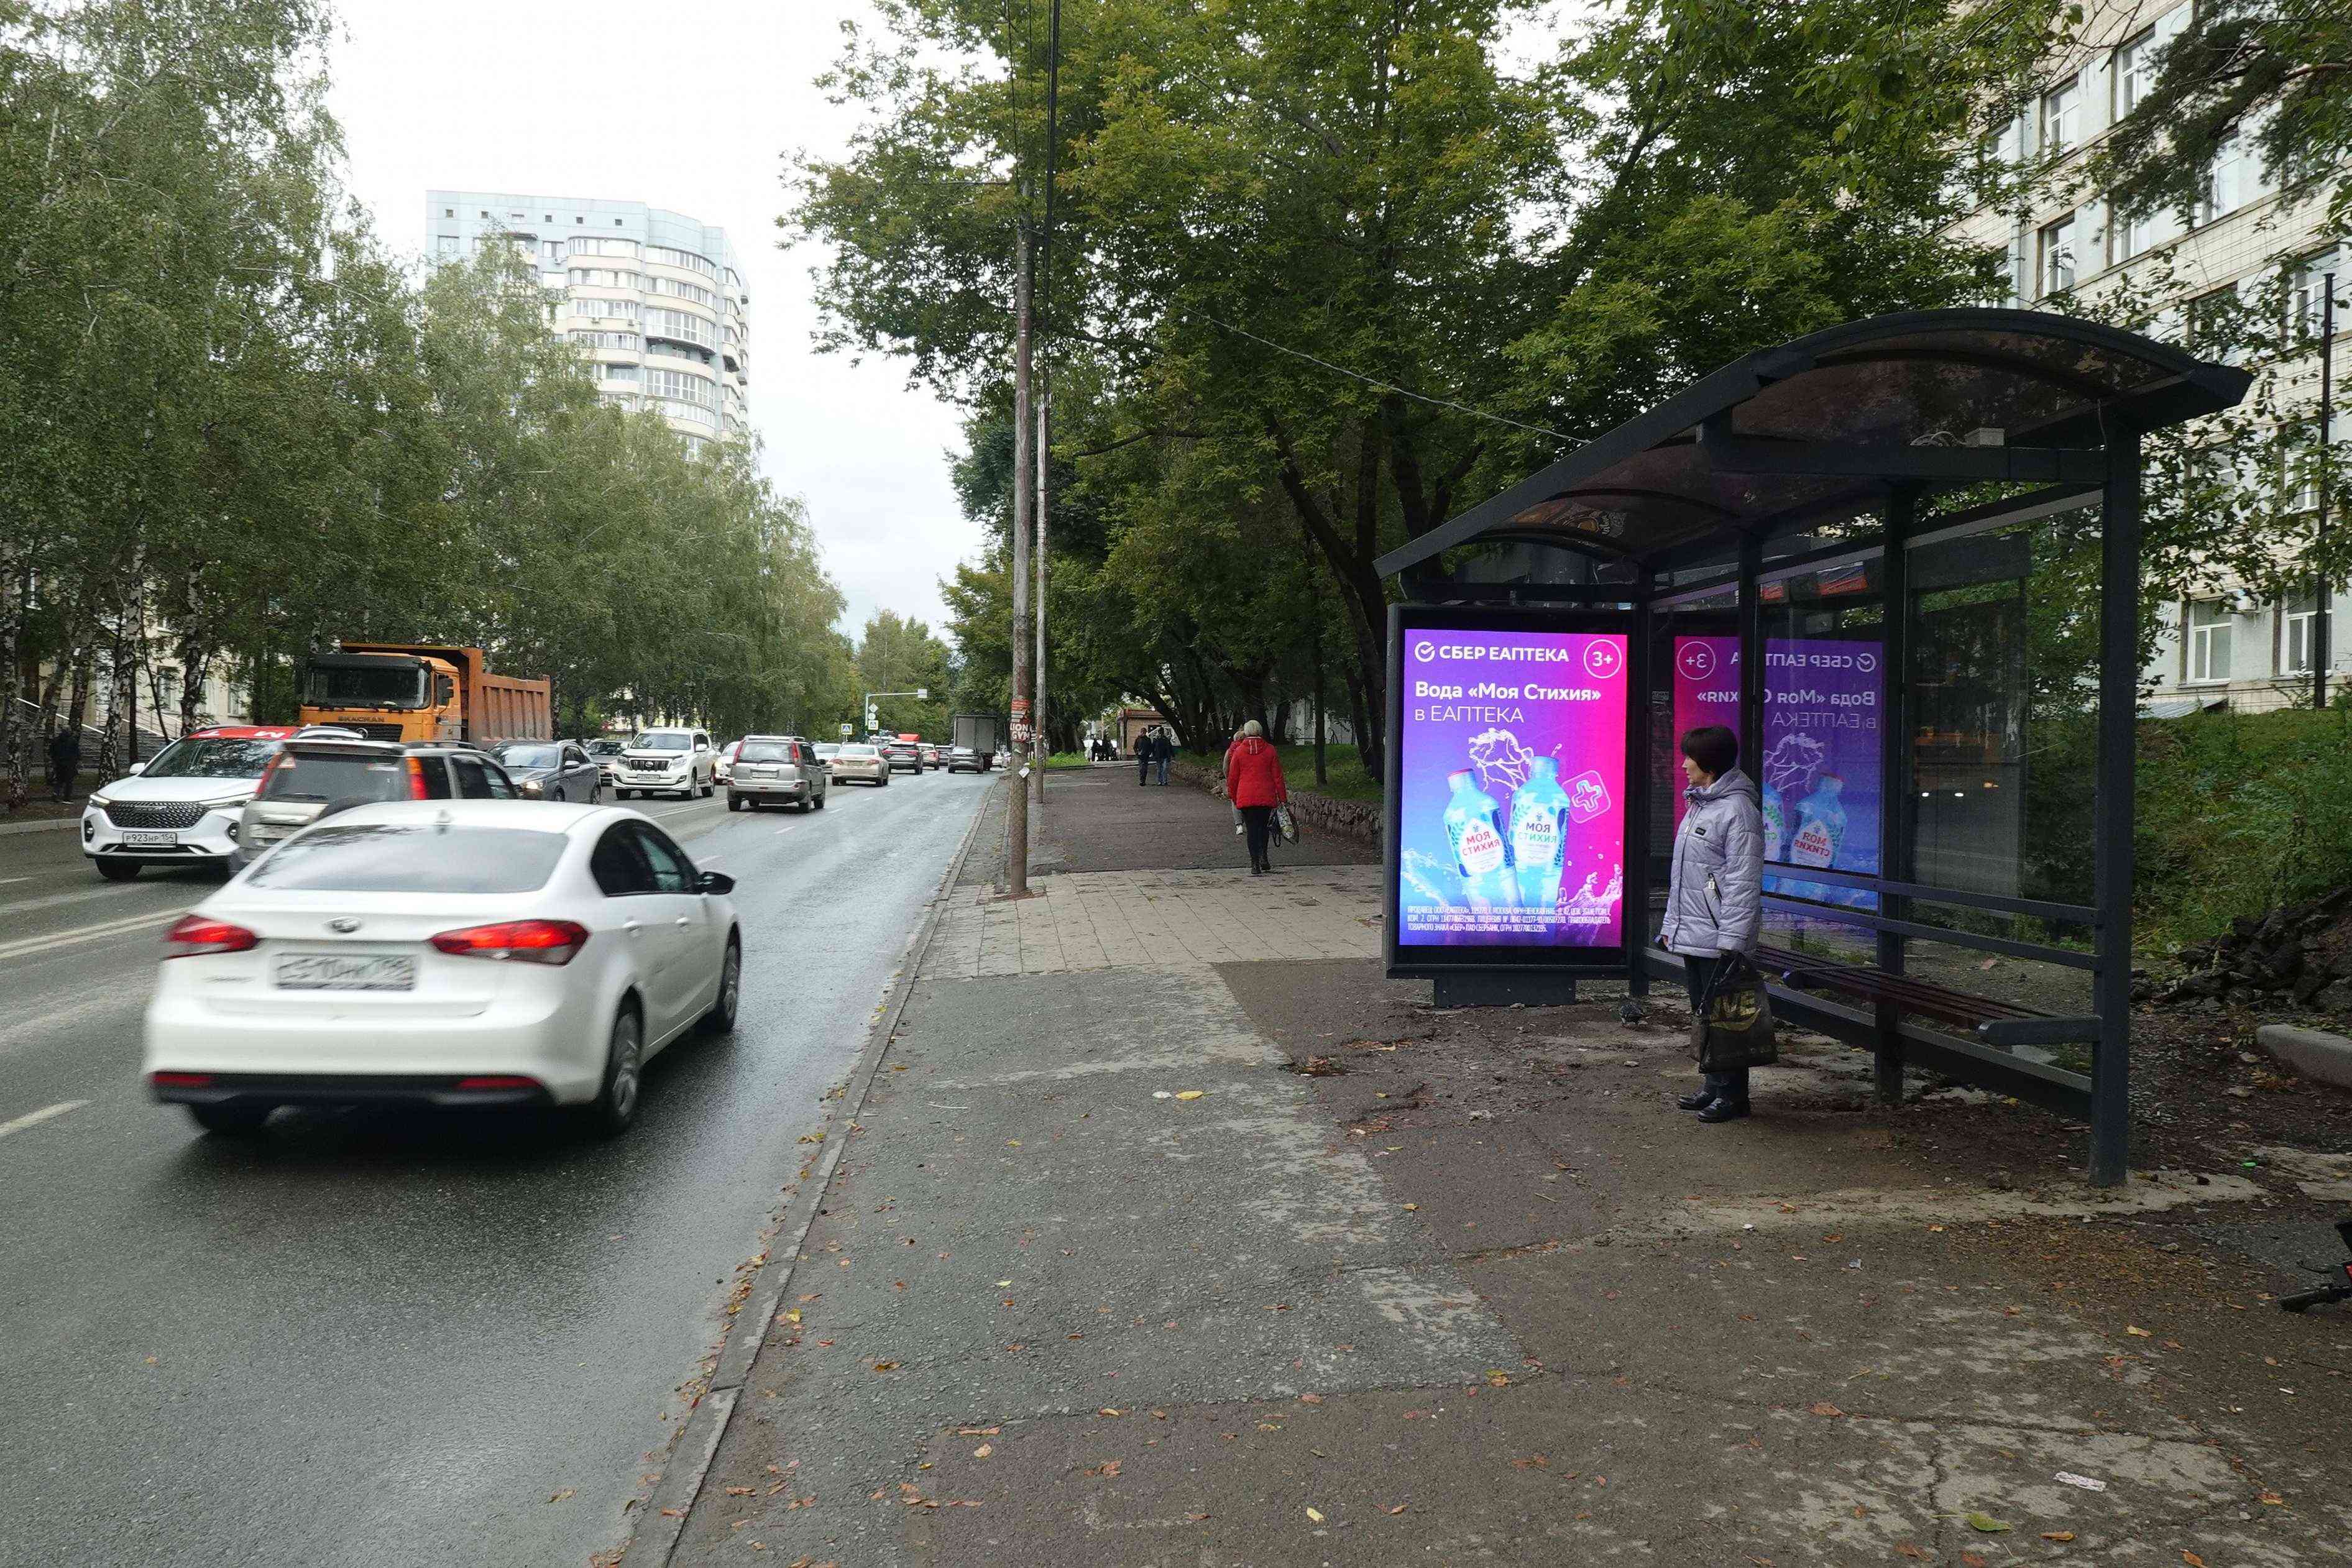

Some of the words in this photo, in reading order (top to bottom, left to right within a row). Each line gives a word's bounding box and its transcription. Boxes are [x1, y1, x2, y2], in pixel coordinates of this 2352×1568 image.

[1439, 645, 1486, 660] СБЕР
[1489, 646, 1569, 663] ЕАПТЕКА
[1591, 651, 1614, 667] 3+
[1415, 681, 1463, 700] Вода
[1468, 682, 1519, 700] «Моя
[1523, 683, 1602, 702] Стихия»
[1415, 708, 1425, 722] в
[1431, 705, 1525, 723] ЕАПТЕКА
[1009, 723, 1029, 732] LION
[1525, 822, 1551, 833] МОЯ
[1466, 830, 1491, 845] МОЯ
[1518, 832, 1558, 844] СТИХИЯ
[1462, 839, 1501, 857] СТИХИЯ
